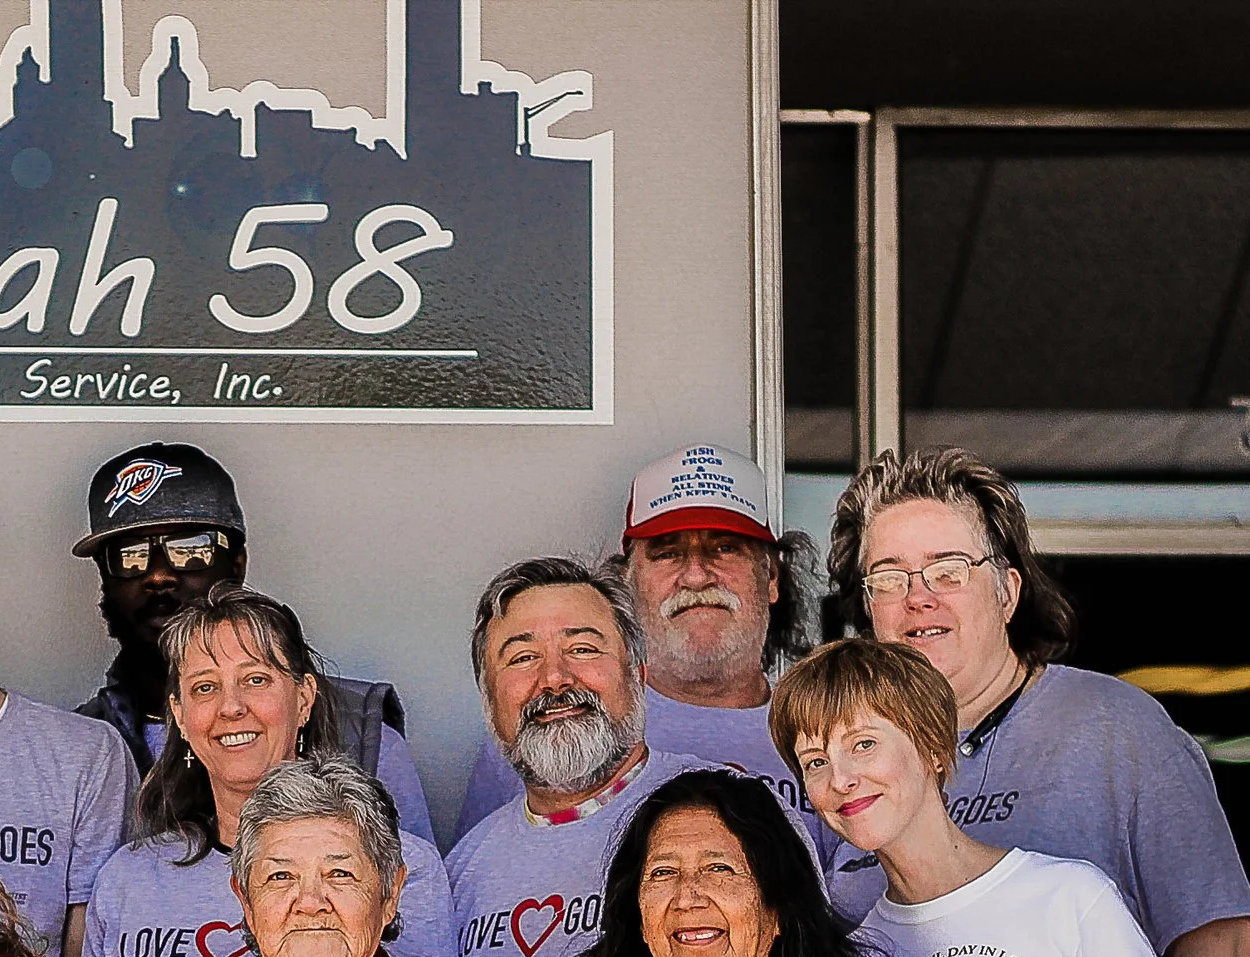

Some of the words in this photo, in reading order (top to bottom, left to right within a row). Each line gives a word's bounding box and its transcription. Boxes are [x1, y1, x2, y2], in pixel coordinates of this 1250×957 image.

[207, 201, 455, 337] 58
[20, 359, 182, 405] Service,
[214, 362, 284, 401] Inc.
[685, 447, 715, 457] FISH
[681, 456, 723, 467] FROGS
[696, 465, 706, 473] &
[115, 466, 154, 500] OKC
[671, 473, 735, 485] RELATIVES
[672, 482, 694, 492] ALL
[697, 482, 733, 493] STINK
[649, 491, 682, 509] WHEN
[950, 790, 1020, 825] GOES
[563, 894, 602, 936] GO
[947, 944, 978, 957] DAY
[979, 945, 997, 957] IN
